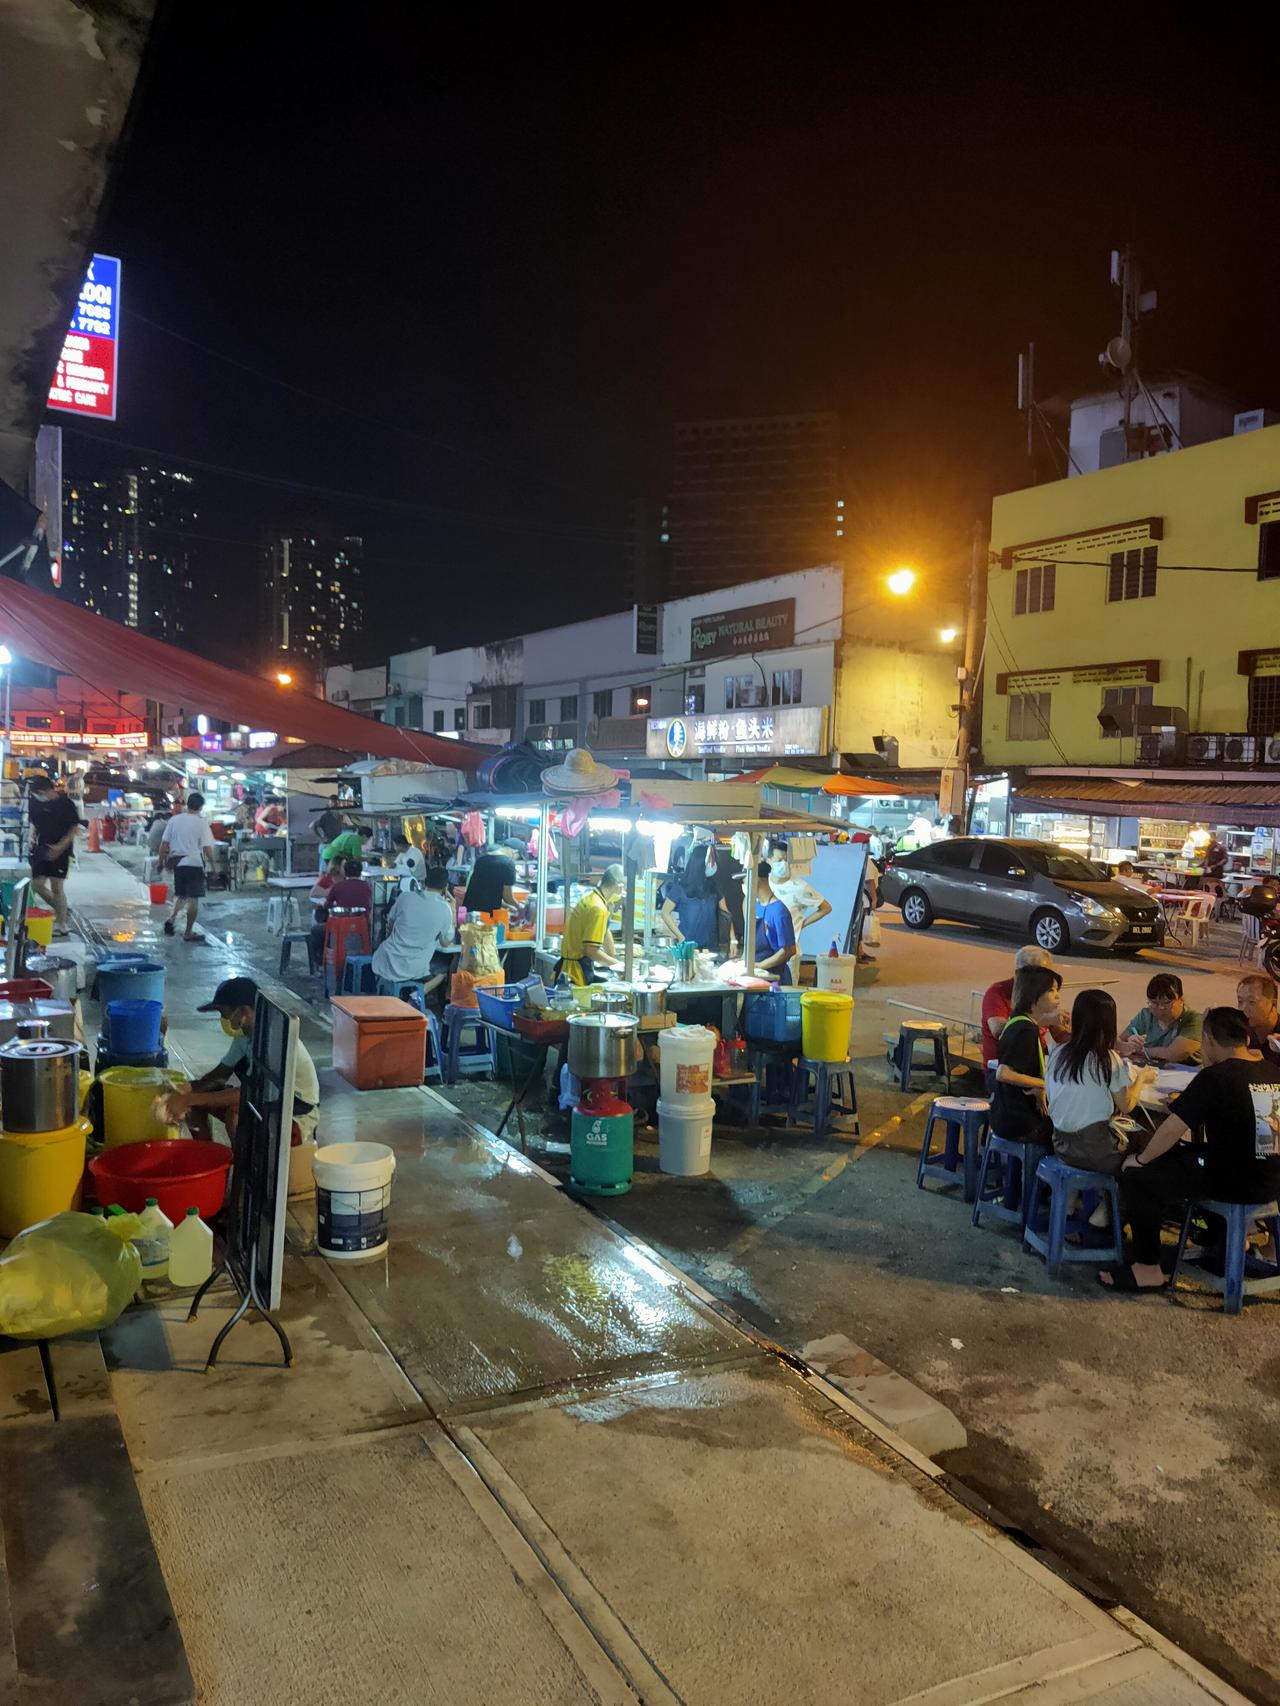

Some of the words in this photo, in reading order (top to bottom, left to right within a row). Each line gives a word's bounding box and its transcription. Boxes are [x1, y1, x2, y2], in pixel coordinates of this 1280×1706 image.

[74, 391, 97, 407] CARE
[718, 619, 754, 637] NATURAL
[755, 613, 788, 630] BEAUTY
[586, 1133, 608, 1141] GAS
